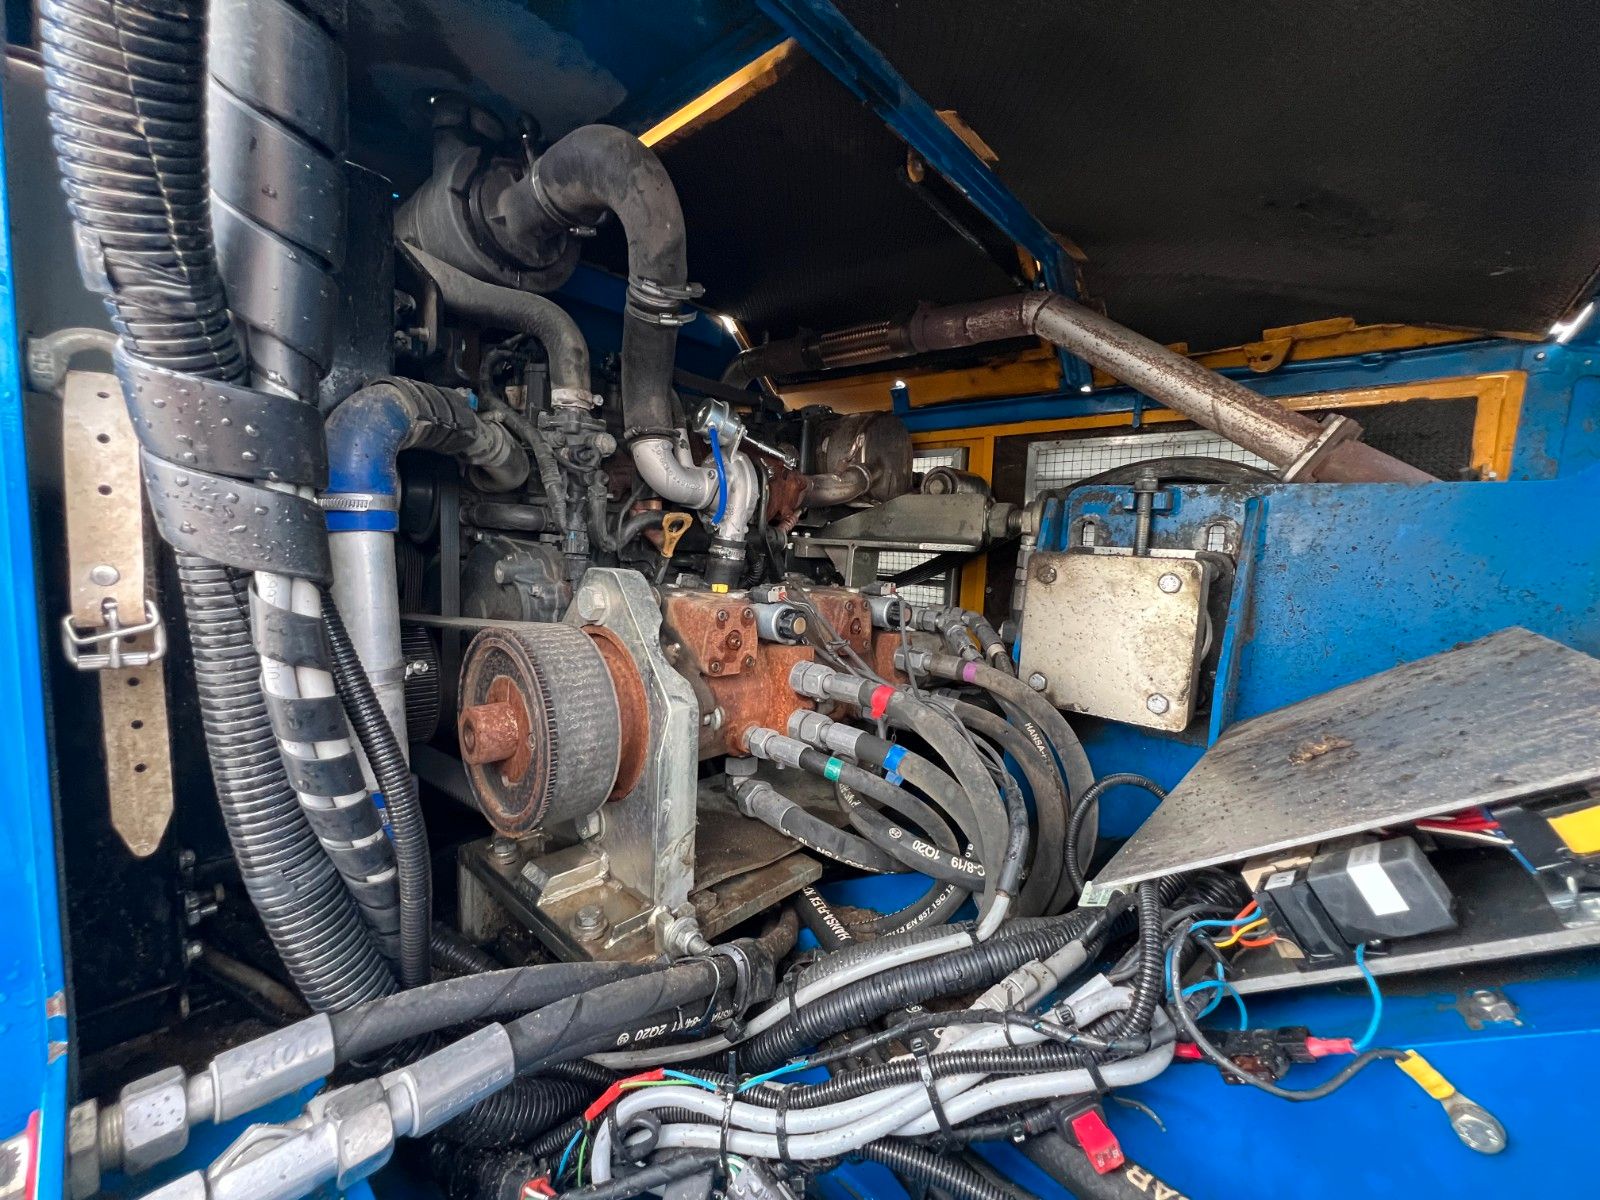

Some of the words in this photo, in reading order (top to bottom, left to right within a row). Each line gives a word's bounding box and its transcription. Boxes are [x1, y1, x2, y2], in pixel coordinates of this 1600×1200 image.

[912, 839, 941, 861] 1Q20
[809, 897, 852, 941] HANSA-FLEX
[906, 918, 918, 930] EN
[918, 907, 931, 921] 857
[634, 1023, 667, 1041] 2Q20
